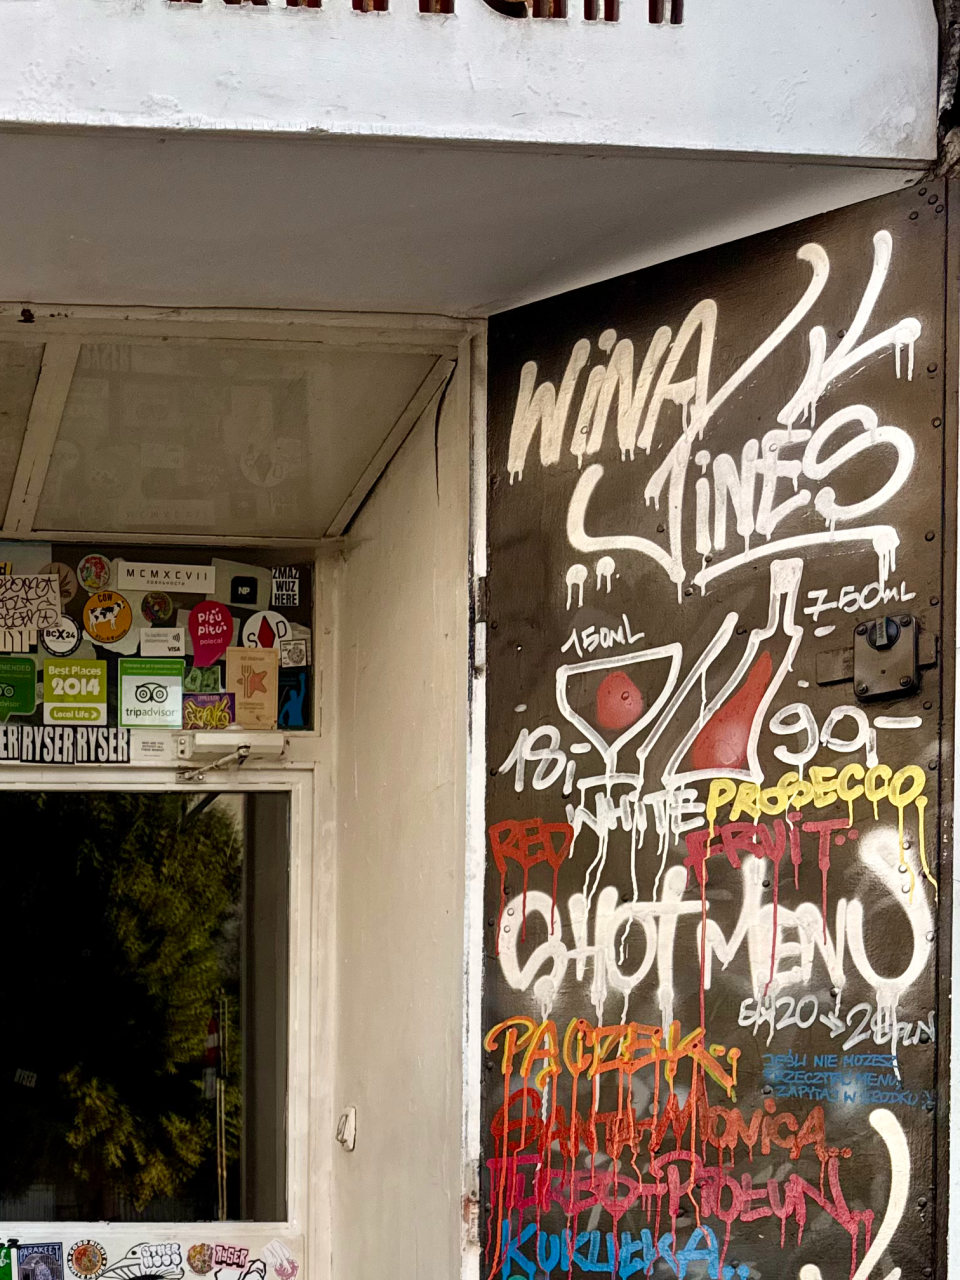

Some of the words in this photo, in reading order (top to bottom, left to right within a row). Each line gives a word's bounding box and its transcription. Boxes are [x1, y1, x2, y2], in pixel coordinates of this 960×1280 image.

[272, 567, 300, 580] ZMAZ
[276, 580, 297, 593] WUZ
[274, 593, 298, 606] HERE
[48, 666, 70, 675] Best
[71, 667, 102, 676] Places
[51, 677, 100, 696] 2014
[53, 710, 73, 718] Local
[74, 710, 90, 718] Life
[126, 707, 177, 719] tripadvisor
[21, 726, 74, 763] RYSER
[76, 727, 130, 763] RYSER
[488, 817, 576, 873] RED
[814, 1053, 838, 1068] NIE
